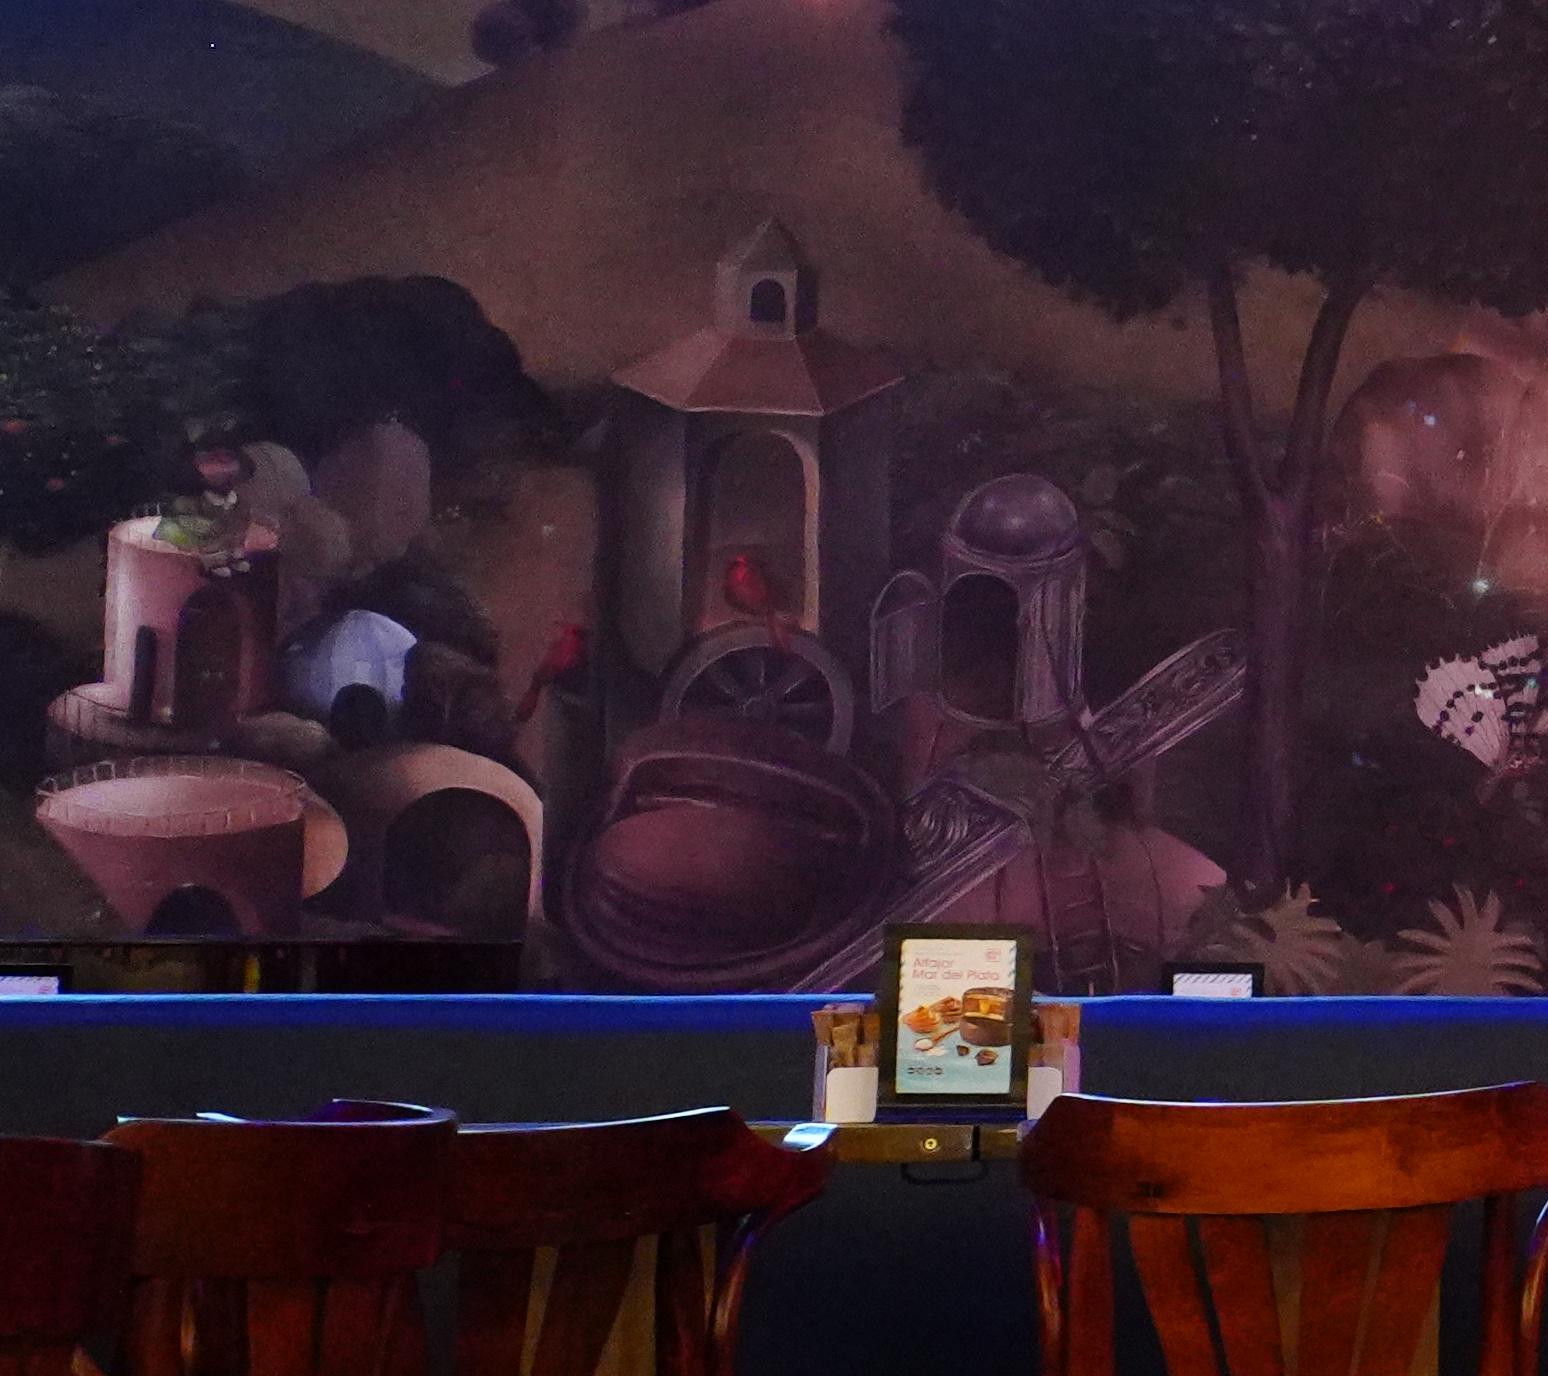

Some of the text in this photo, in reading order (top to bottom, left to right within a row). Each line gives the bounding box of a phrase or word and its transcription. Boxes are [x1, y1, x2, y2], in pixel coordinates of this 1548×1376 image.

[913, 957, 955, 969] Alfajor
[911, 969, 1000, 981] Mar del Plata
